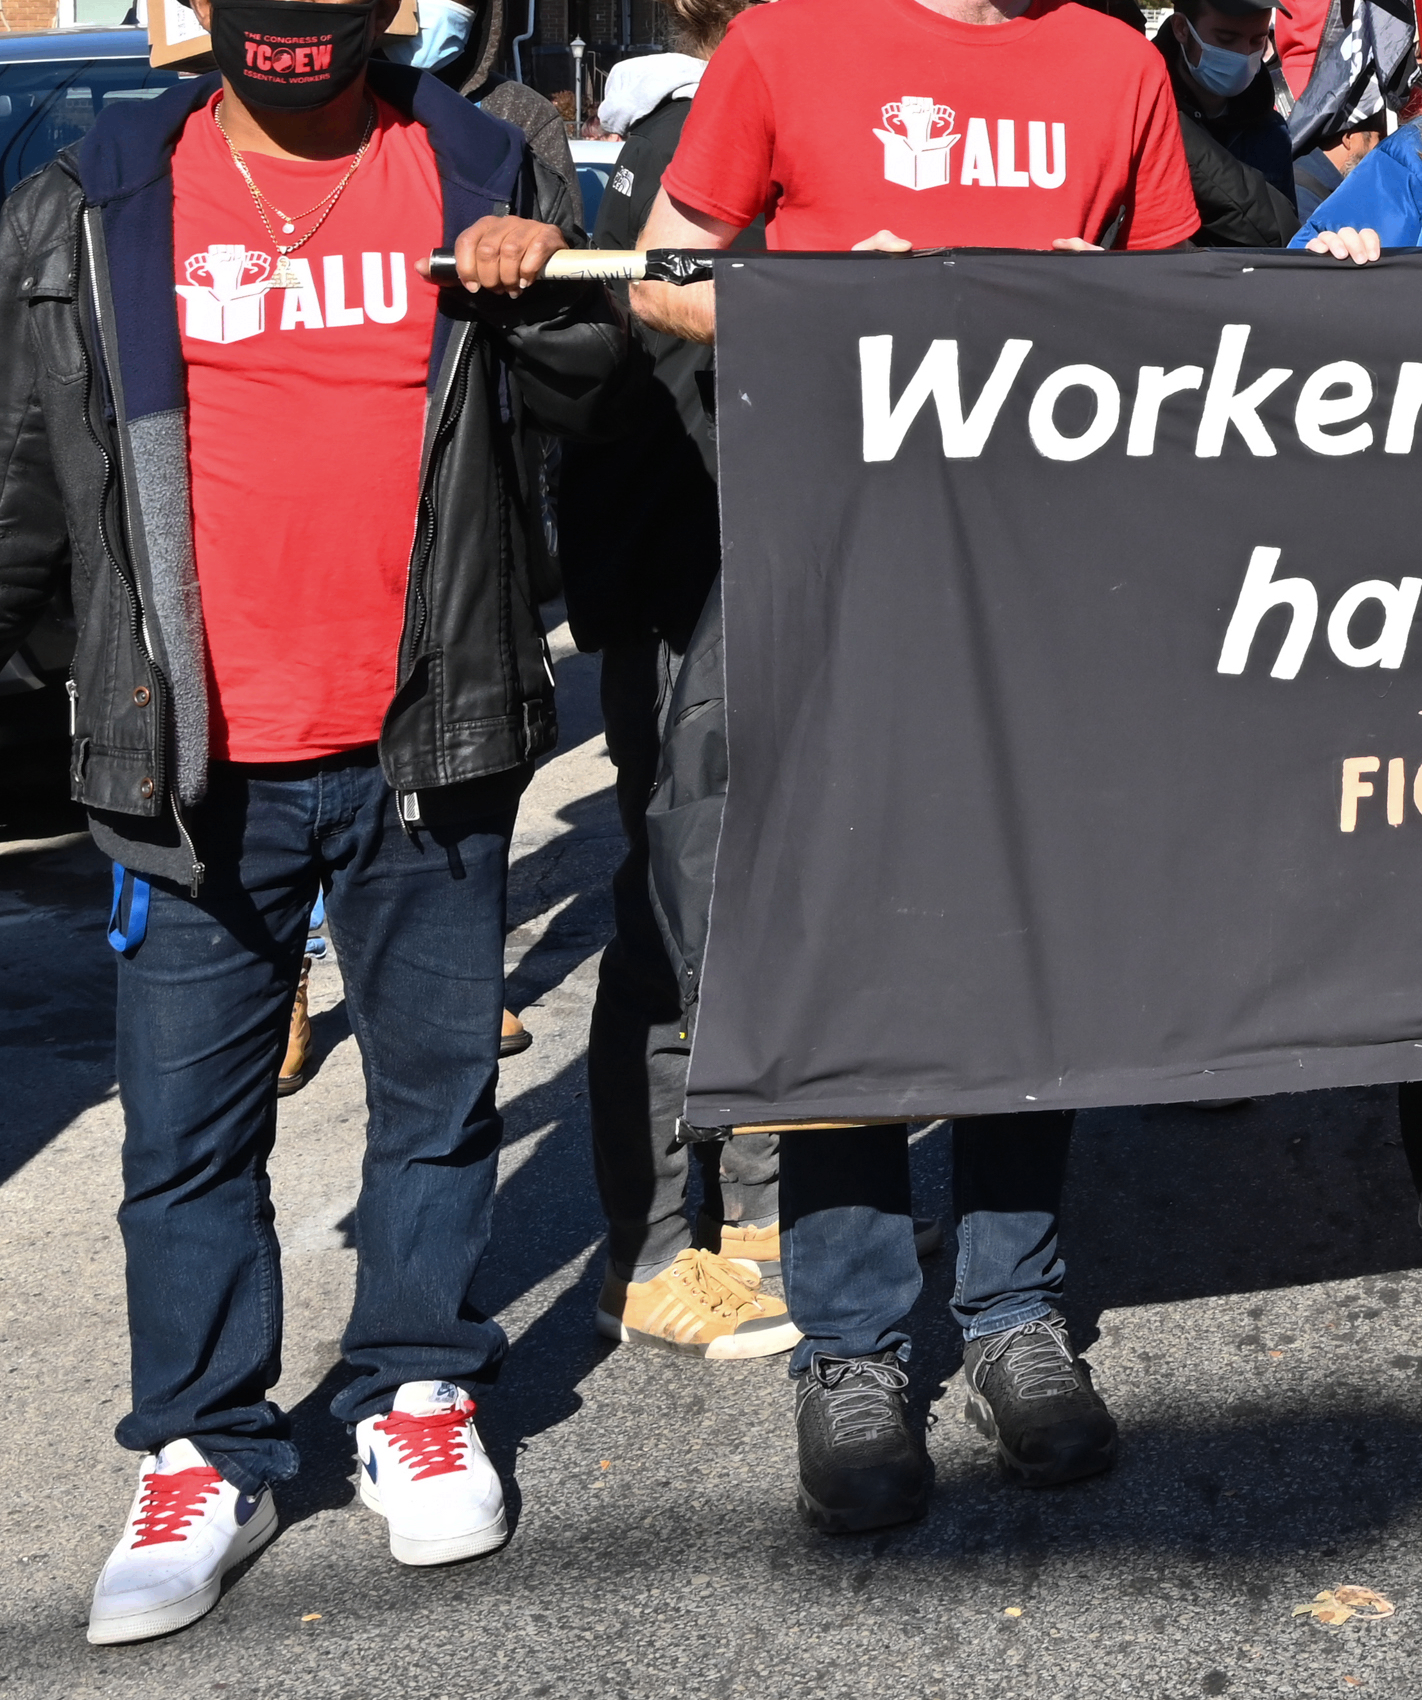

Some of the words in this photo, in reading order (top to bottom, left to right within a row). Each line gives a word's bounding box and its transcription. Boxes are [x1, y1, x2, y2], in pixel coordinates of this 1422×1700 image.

[244, 31, 261, 40] THE
[263, 35, 318, 44] CONGRESS
[320, 34, 333, 42] OF
[243, 69, 287, 84] ESSENTIAL
[289, 73, 331, 84] WORKERS
[960, 117, 1067, 189] ALU
[280, 252, 408, 330] ALU
